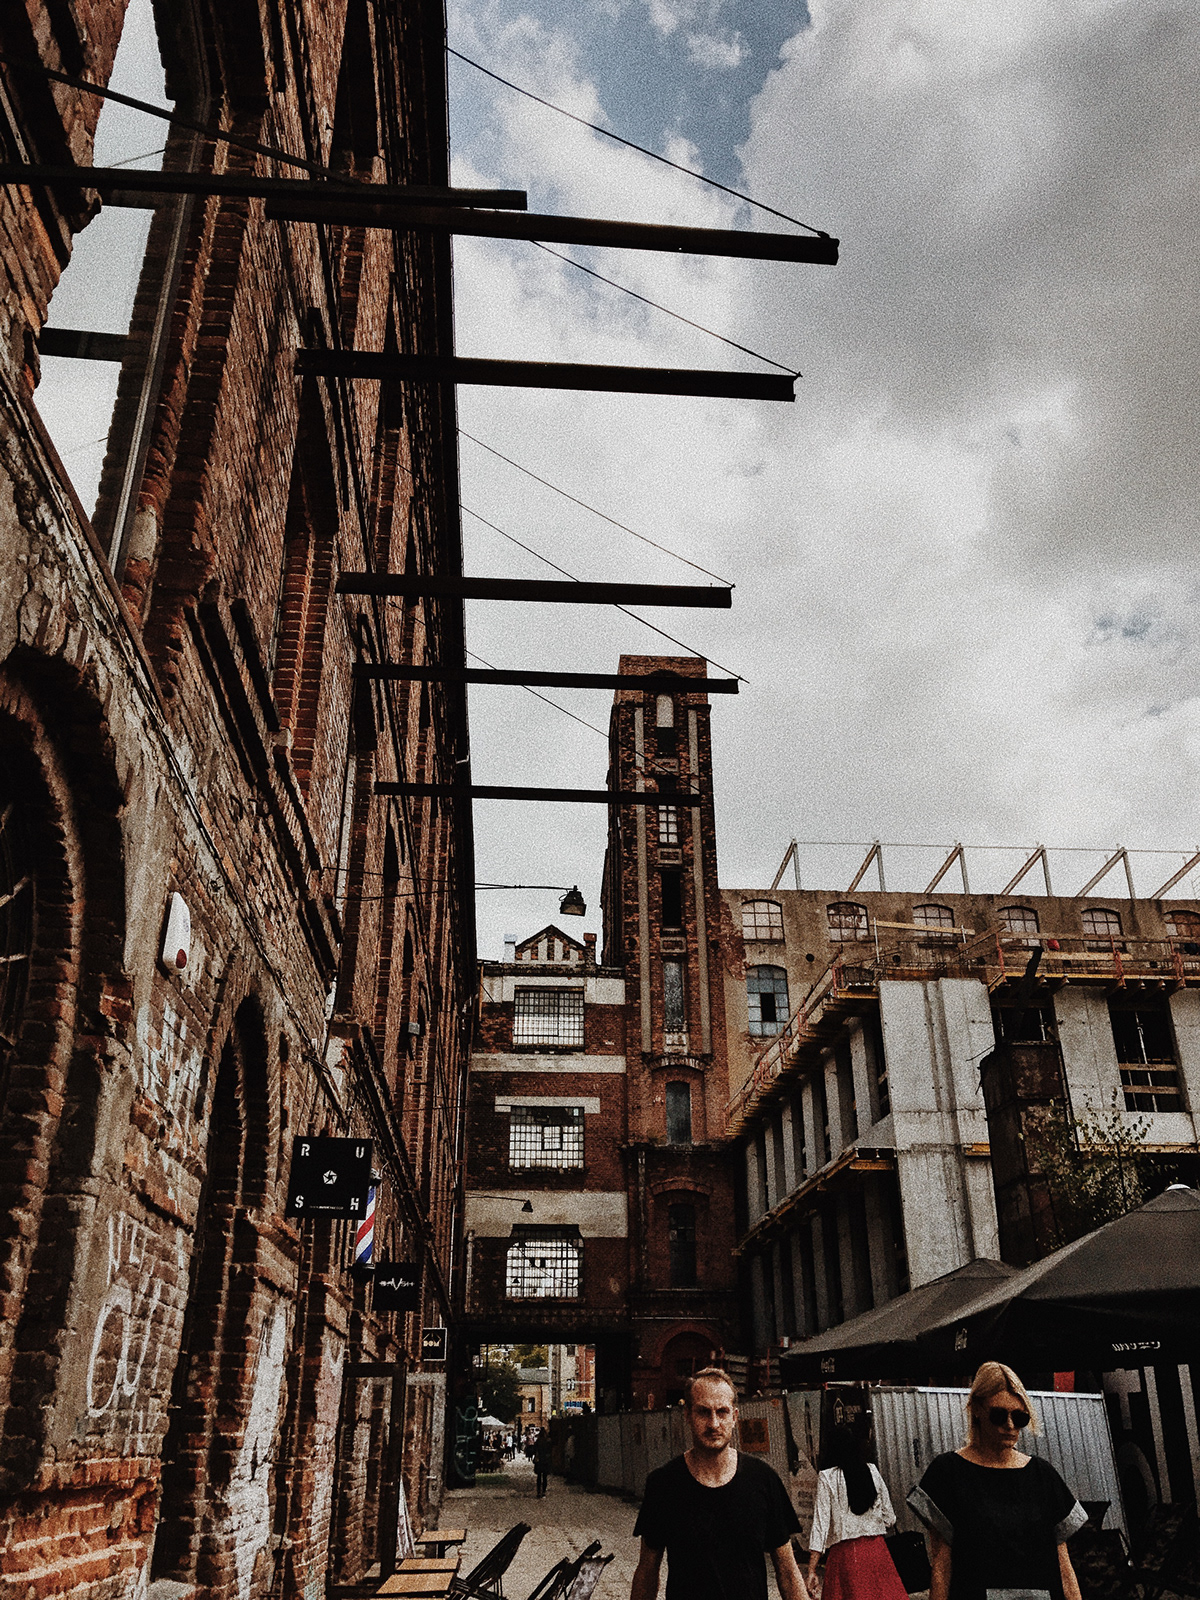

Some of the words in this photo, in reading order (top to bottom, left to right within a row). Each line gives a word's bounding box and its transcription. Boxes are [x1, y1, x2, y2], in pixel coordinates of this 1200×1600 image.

[300, 1143, 311, 1157] R
[355, 1146, 365, 1159] U
[294, 1194, 305, 1209] S
[349, 1197, 360, 1211] H
